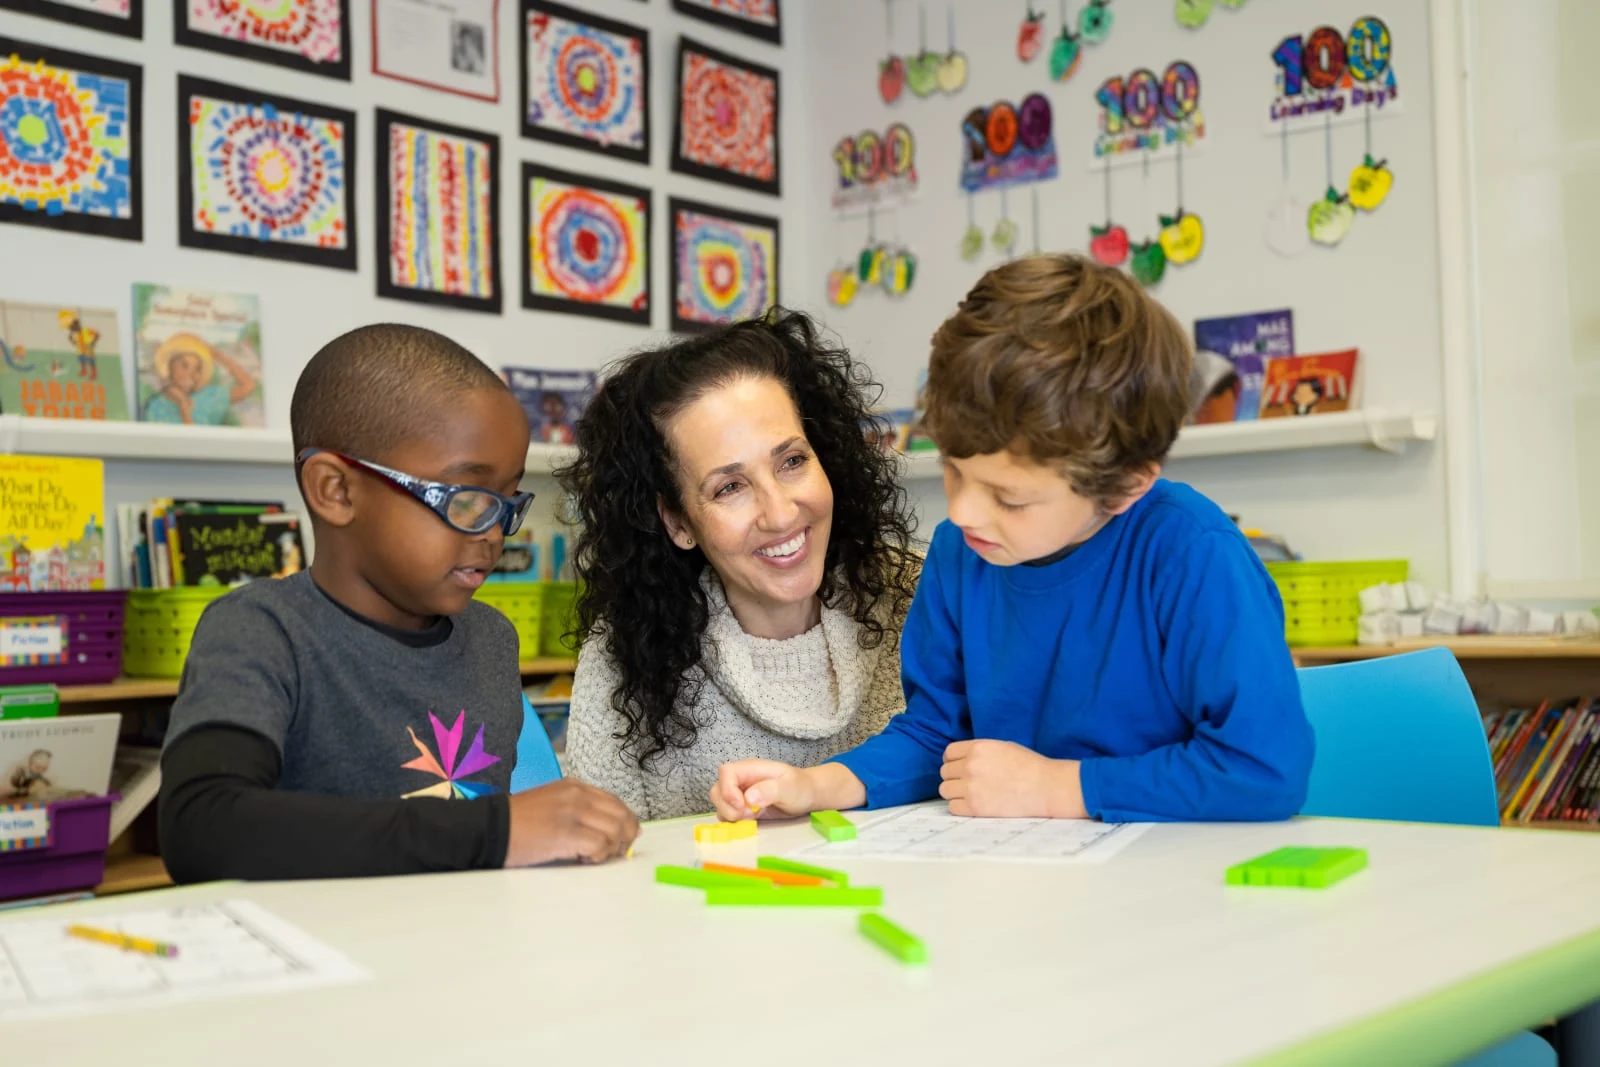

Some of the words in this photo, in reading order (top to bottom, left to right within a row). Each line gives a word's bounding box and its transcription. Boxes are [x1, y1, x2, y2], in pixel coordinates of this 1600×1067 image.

[1271, 16, 1391, 96] 100
[1095, 60, 1199, 134] 100
[1270, 93, 1344, 120] Learning
[962, 93, 1052, 162] 100
[831, 122, 914, 188] 100
[20, 379, 106, 403] JABARI
[38, 479, 63, 497] Do
[2, 495, 50, 515] People
[54, 496, 77, 513] Do
[7, 514, 29, 529] All
[11, 632, 49, 646] Fiction
